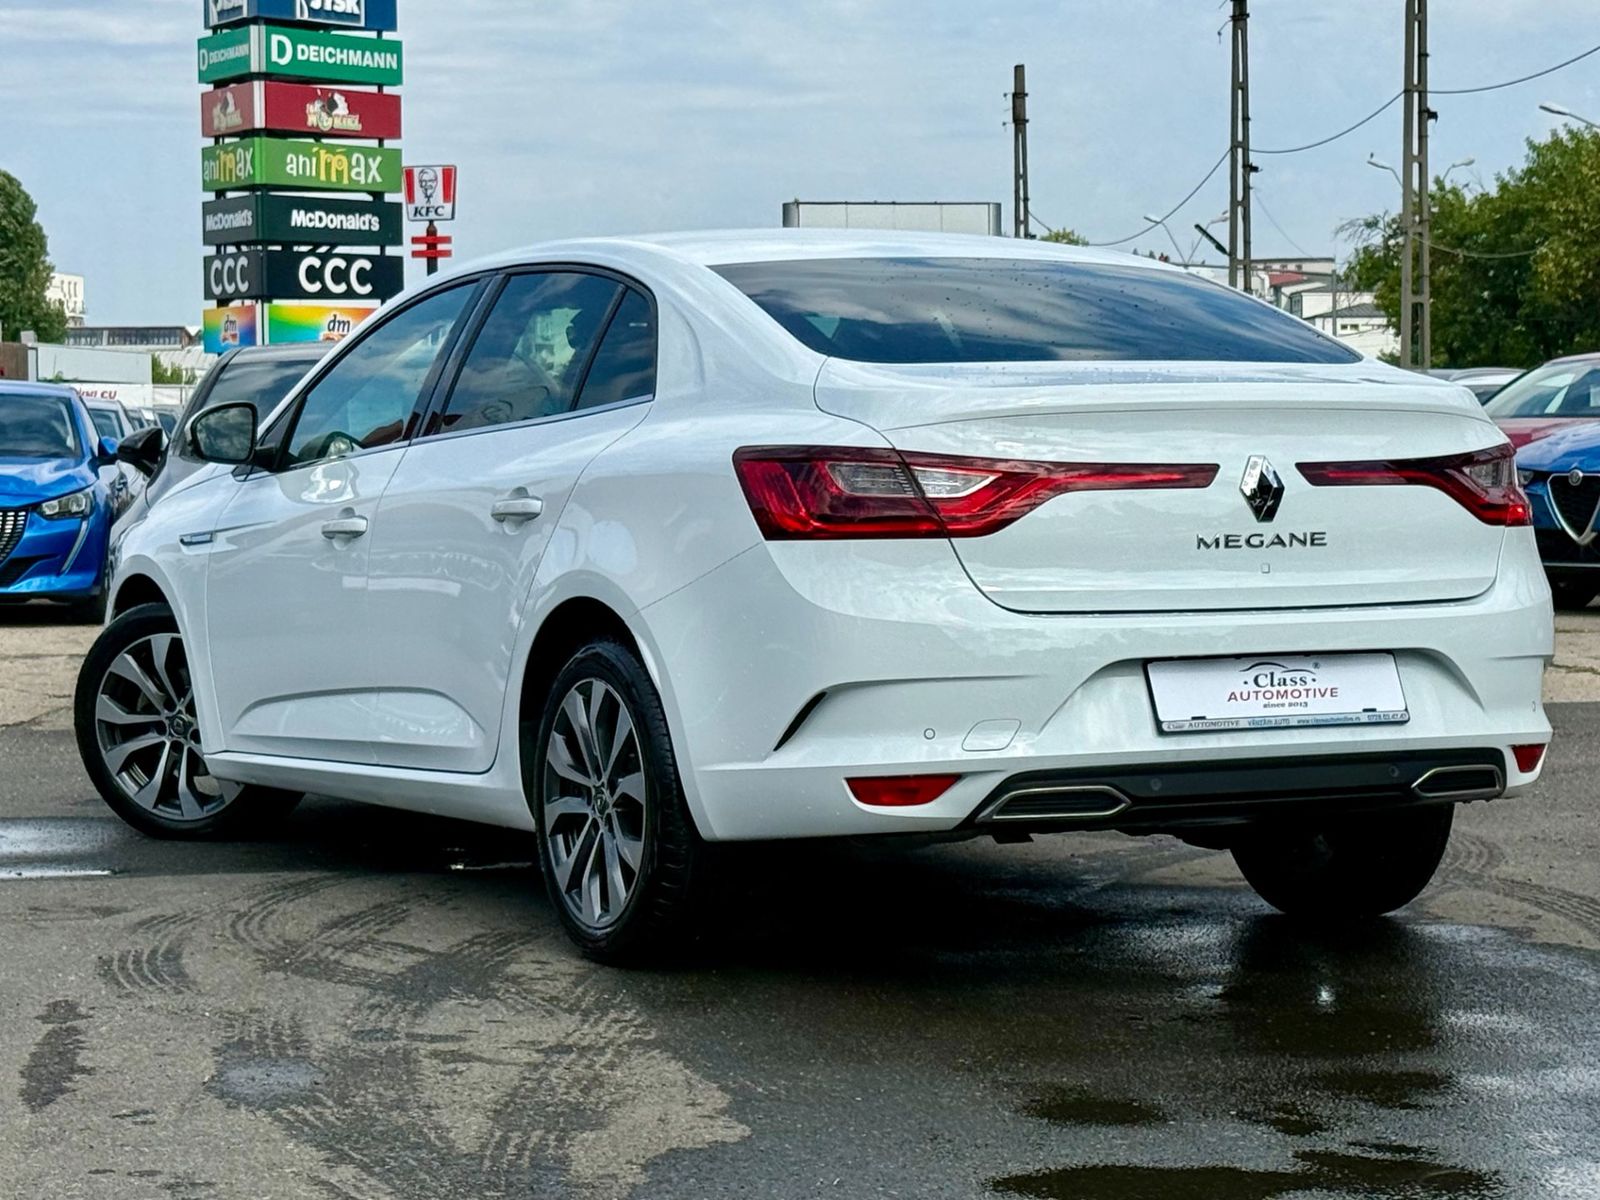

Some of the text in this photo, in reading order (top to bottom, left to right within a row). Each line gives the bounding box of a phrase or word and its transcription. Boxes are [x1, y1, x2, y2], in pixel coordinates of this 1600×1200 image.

[297, 44, 398, 70] DEICHMANN
[203, 146, 254, 182] animax
[286, 147, 383, 184] animax
[206, 209, 253, 231] McDonald's
[291, 209, 380, 231] McDonald's
[413, 205, 445, 217] KFC
[210, 256, 249, 295] CCC
[298, 255, 373, 295] CCC
[327, 314, 350, 332] dm
[1196, 532, 1327, 550] MEGANE
[1253, 671, 1308, 688] Class
[1227, 687, 1339, 702] AUTOMOTIVE
[1263, 701, 1309, 709] since 2013
[1188, 719, 1240, 729] AUTOMOTIVE
